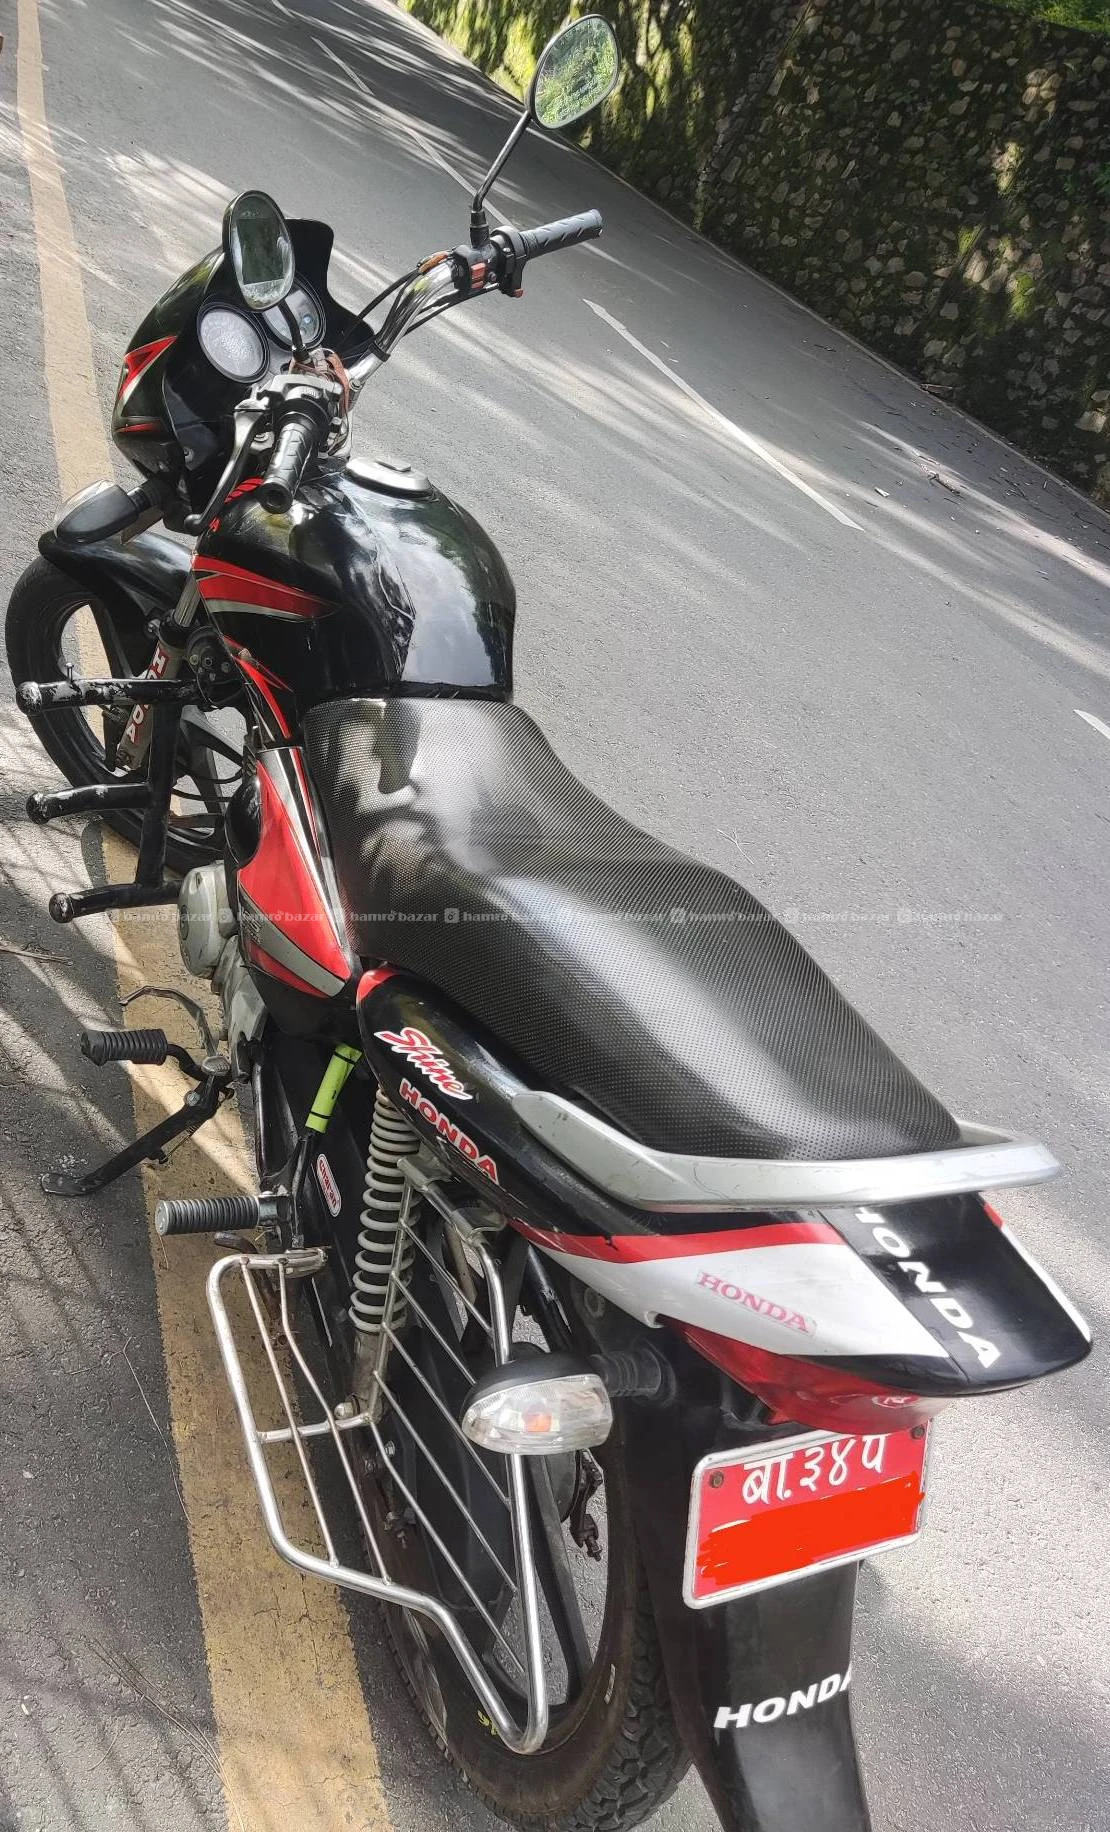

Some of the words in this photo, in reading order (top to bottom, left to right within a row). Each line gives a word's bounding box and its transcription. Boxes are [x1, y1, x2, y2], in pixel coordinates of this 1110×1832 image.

[374, 1027, 473, 1100] Shine
[400, 1078, 499, 1184] HONDA
[696, 1272, 810, 1334] HONDA
